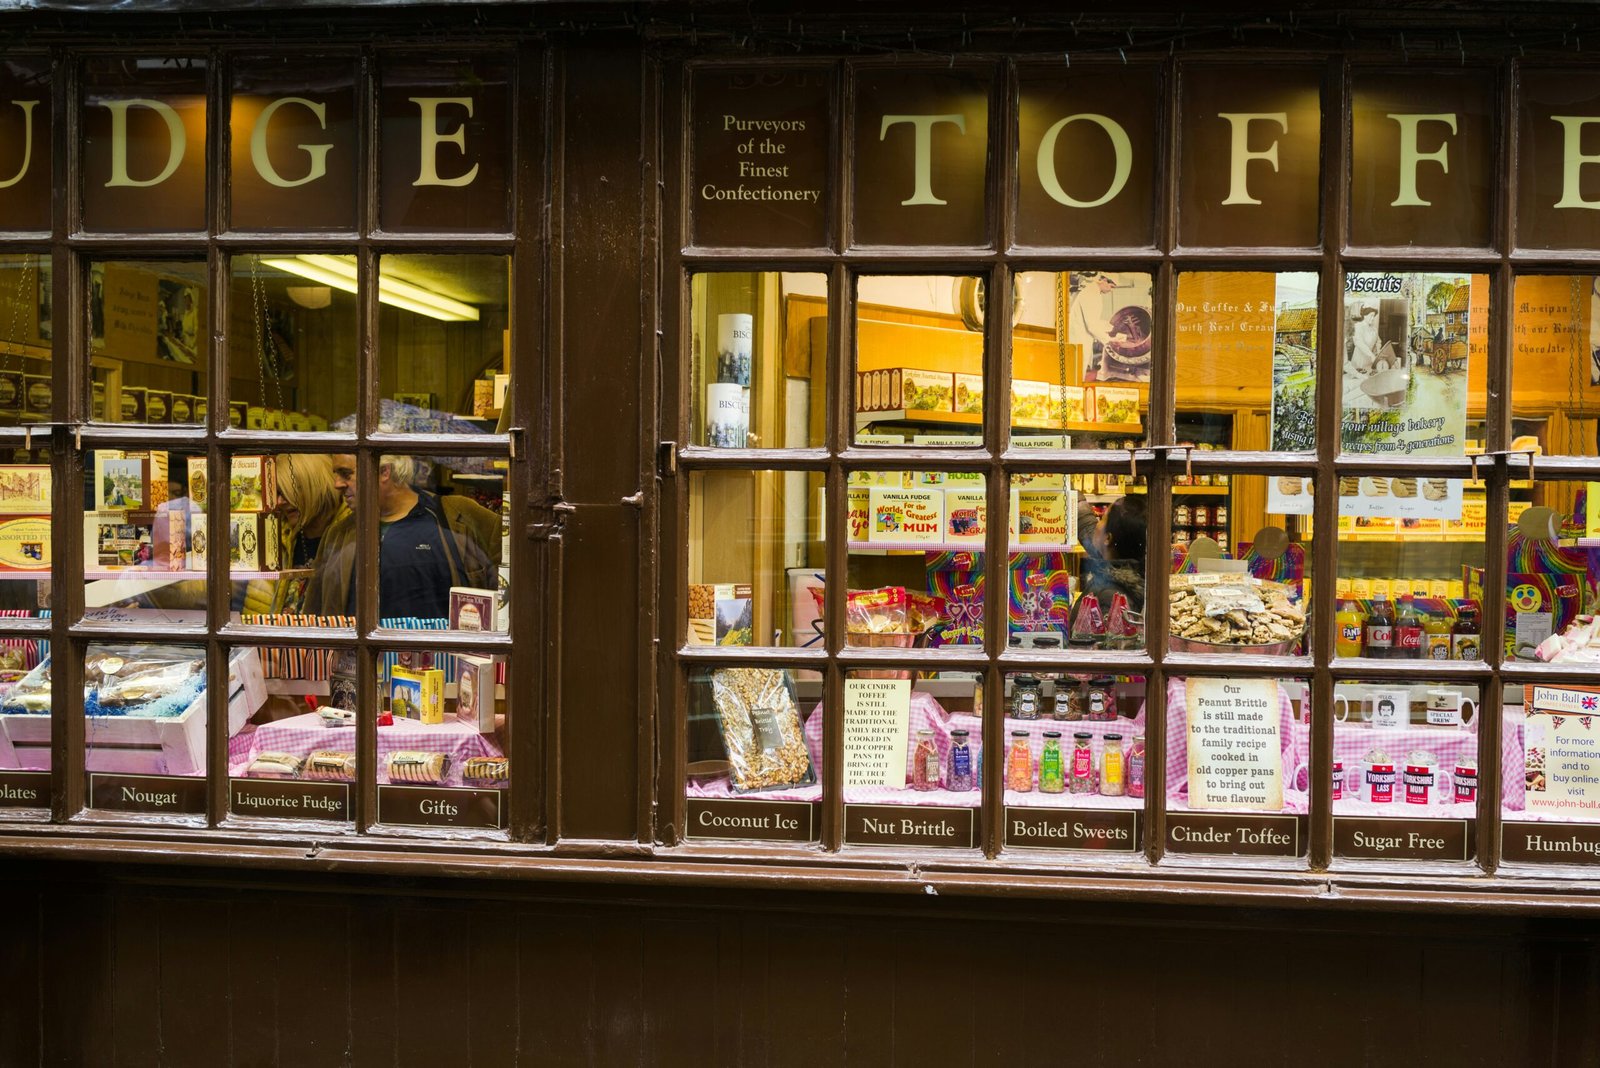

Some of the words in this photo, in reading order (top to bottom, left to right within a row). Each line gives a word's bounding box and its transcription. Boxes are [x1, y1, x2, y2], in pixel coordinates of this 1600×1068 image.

[723, 115, 806, 133] Purveyors
[737, 141, 754, 155] of
[760, 139, 786, 155] the
[879, 112, 1600, 210] TOFFE
[739, 161, 789, 178] Finest
[702, 184, 821, 204] Confectionery
[1243, 302, 1253, 313] &
[1514, 323, 1527, 336] ith
[1518, 343, 1566, 355] Chocolate
[1369, 418, 1406, 437] village
[1407, 416, 1446, 432] bakery
[1345, 438, 1373, 452] recipes
[1373, 438, 1397, 453] from
[1397, 439, 1405, 450] 4
[1404, 433, 1455, 454] generations
[877, 504, 904, 514] Worlds
[1020, 509, 1035, 519] orlds
[1033, 505, 1042, 513] For
[905, 509, 937, 521] Greatest
[903, 523, 937, 533] MUM
[1223, 685, 1241, 694] Our
[1537, 690, 1559, 701] John
[1561, 692, 1580, 704] Bull
[1198, 698, 1232, 707] Peanut
[1235, 698, 1268, 708] Brittle
[1203, 711, 1212, 720] is
[1215, 711, 1235, 720] still
[1238, 712, 1264, 721] made
[1191, 725, 1201, 733] to
[1205, 725, 1220, 733] the
[1223, 725, 1277, 735] traditional
[1202, 739, 1233, 749] family
[1236, 740, 1267, 750] recipe
[1555, 735, 1570, 745] For
[1571, 738, 1595, 747] more
[862, 744, 894, 752] COPPER
[1211, 752, 1245, 761] cooked
[1248, 753, 1259, 761] in
[1550, 749, 1600, 759] information
[1196, 766, 1212, 775] old
[1215, 768, 1248, 777] copper
[1251, 768, 1275, 777] pans
[1561, 762, 1579, 771] and
[1580, 763, 1590, 771] to
[1553, 774, 1570, 784] buy
[1571, 775, 1600, 784] online
[1206, 780, 1217, 788] to
[1220, 780, 1246, 791] bring
[1249, 781, 1265, 790] out
[1376, 784, 1390, 793] LASS
[1409, 785, 1424, 794] MUM
[121, 787, 177, 804] Nougat
[1567, 787, 1585, 796] visit
[237, 792, 299, 812] Liquorice
[302, 795, 342, 811] Fudge
[1207, 794, 1228, 803] true
[1231, 794, 1266, 804] flavour
[419, 799, 458, 816] Gifts
[699, 811, 770, 829] Coconut
[775, 813, 799, 830] Ice
[863, 818, 896, 835] Nut
[901, 819, 955, 837] Brittle
[1013, 820, 1068, 838] Boiled
[1073, 823, 1128, 840] Sweets
[1171, 826, 1232, 843] Cinder
[1236, 828, 1290, 845] Toffee
[1353, 831, 1403, 851] Sugar
[1408, 832, 1445, 849] Free
